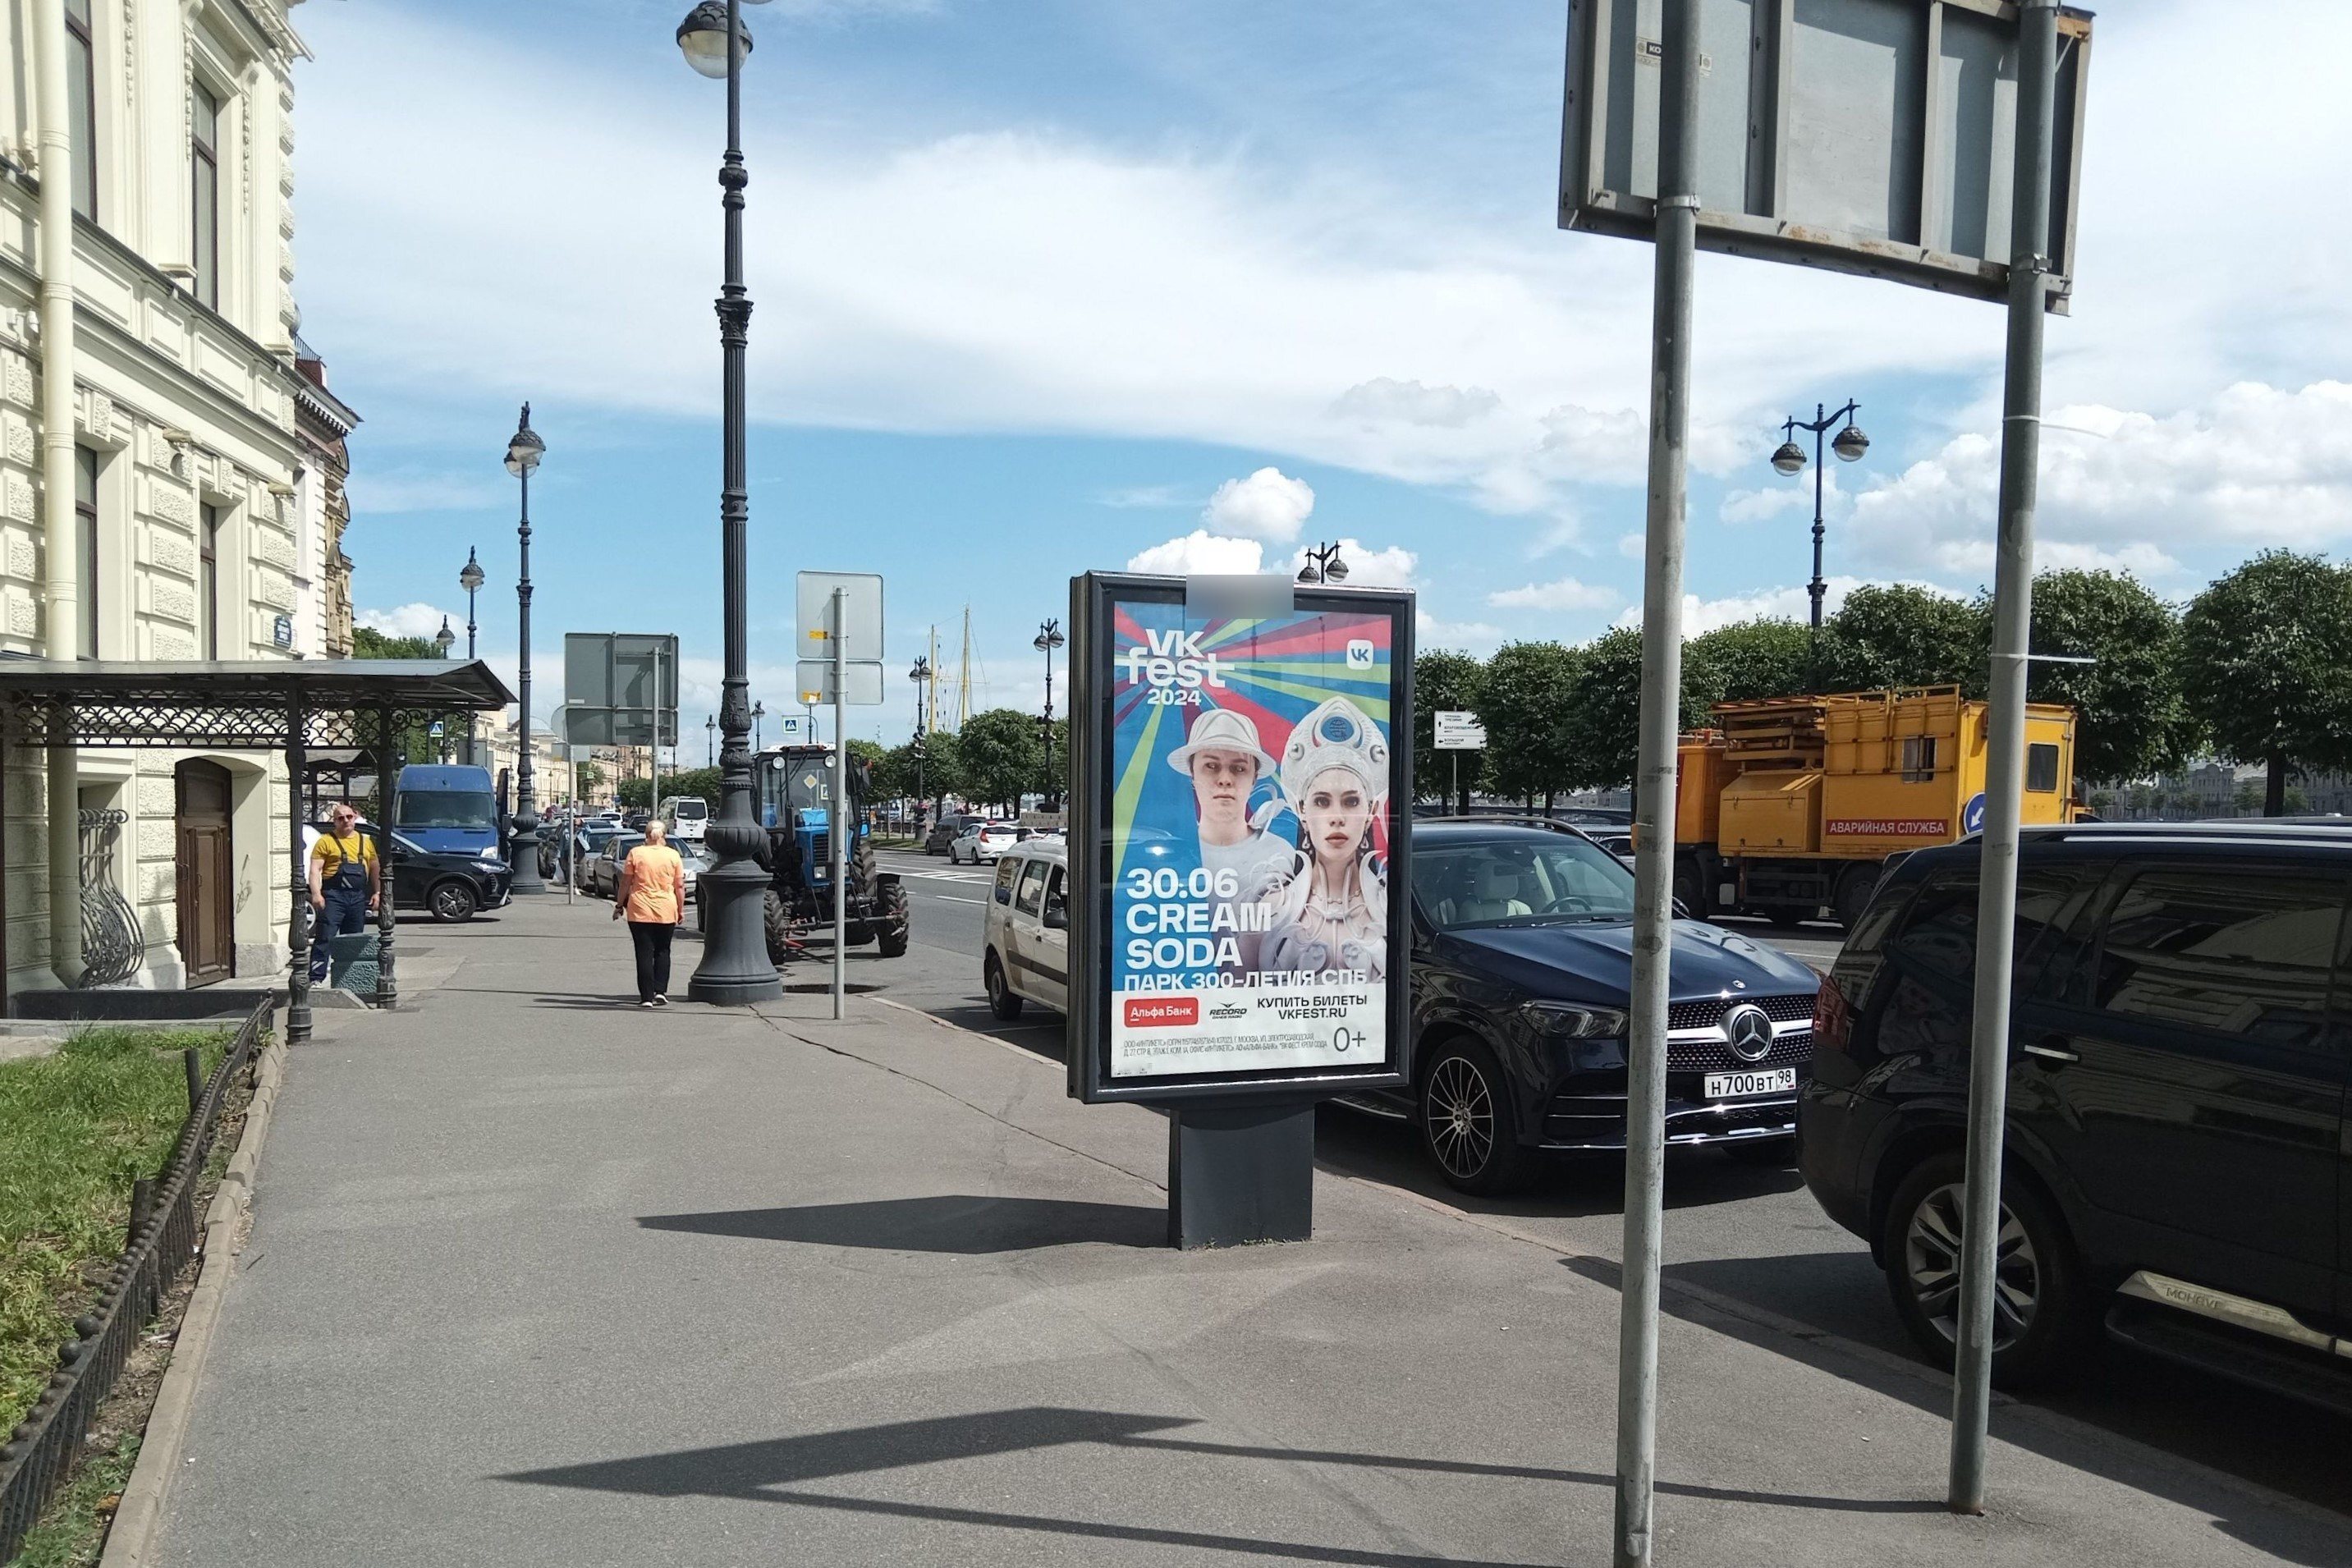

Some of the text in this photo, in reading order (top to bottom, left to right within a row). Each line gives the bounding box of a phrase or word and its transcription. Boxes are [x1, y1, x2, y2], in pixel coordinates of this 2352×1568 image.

[1145, 629, 1203, 658] VK
[1351, 648, 1369, 663] VK
[1126, 646, 1234, 687] fest
[1148, 688, 1202, 706] 2024
[1830, 820, 1945, 834] АВАРИЙНАЯ СЛУЖБА
[1126, 867, 1238, 900] 30.06
[1126, 902, 1271, 934] CREAM
[1126, 937, 1242, 970] SODA
[1124, 969, 1367, 992] ПАРК 300-ЛЕТИЯ СПБ
[1258, 995, 1367, 1008] КУПИТЬ БИЛЕТЫ
[1130, 1006, 1192, 1020] Альфа Банк
[1279, 1008, 1346, 1020] VKFEST.RU
[1334, 1027, 1367, 1052] 0+
[1777, 1070, 1791, 1084] 98
